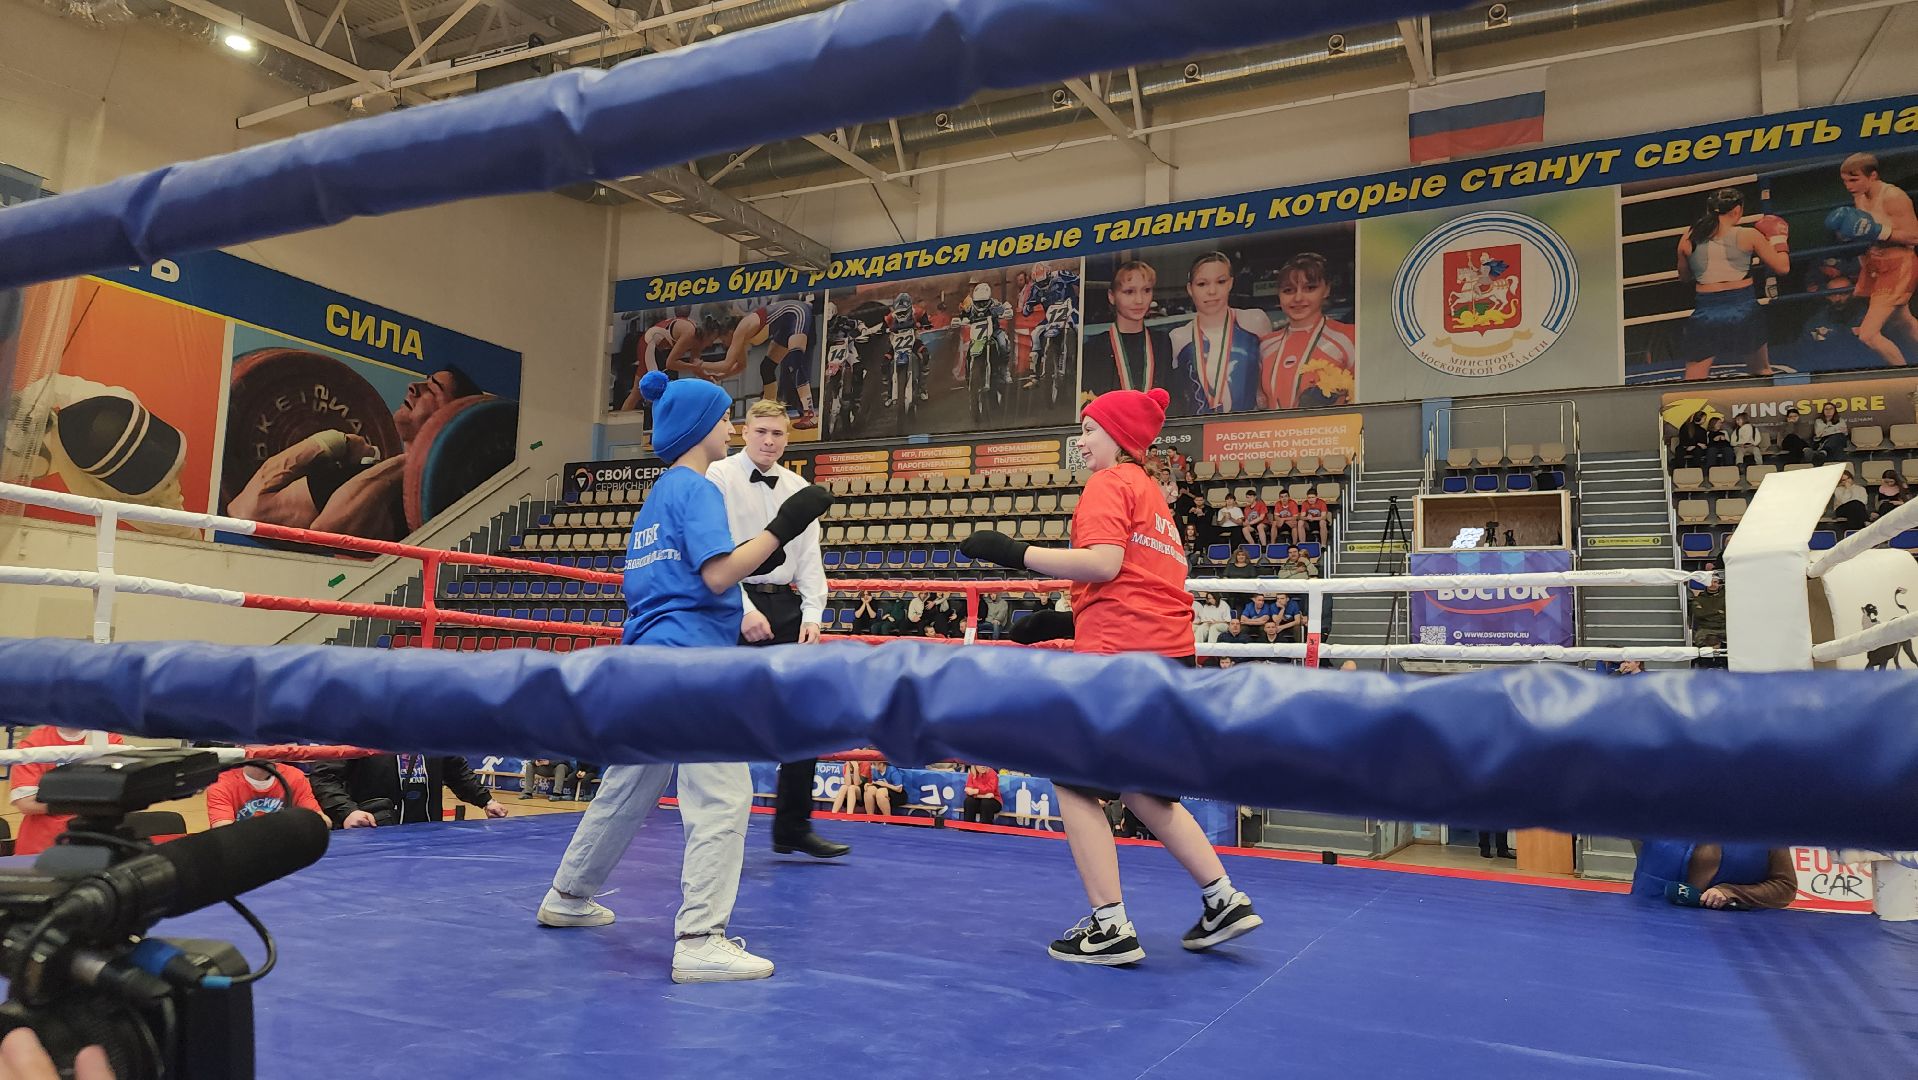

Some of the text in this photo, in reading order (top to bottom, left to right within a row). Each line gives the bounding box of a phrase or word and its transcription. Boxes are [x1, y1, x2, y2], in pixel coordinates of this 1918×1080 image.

[645, 277, 720, 302] Здесь
[977, 226, 1082, 260] новые
[1093, 202, 1255, 244] таланты,
[1268, 173, 1448, 220] которые
[1459, 148, 1622, 191] станут
[1634, 113, 1843, 169] светить
[1050, 306, 1068, 323] 12
[325, 303, 424, 361] СИЛА
[974, 324, 988, 341] 7
[894, 335, 914, 351] 22
[831, 349, 846, 361] 14
[1418, 340, 1550, 376] МОСКОВСКОЙ ОБЛАСТИ
[1449, 351, 1516, 367] МИНСПОРТ
[1215, 425, 1348, 442] РАБОТАЕТ КУРЬЕРСКАЯ
[1223, 436, 1340, 452] СЛУЖБА ПО МОСКВЕ
[829, 453, 880, 462] ТЕЛЕВИЗОРЫ
[993, 455, 1040, 465] ПЫЛЕСОСЫ
[1209, 445, 1356, 462] И МОСКОВСКОЙ ОБЛАСТИ
[832, 465, 871, 473] ТЕЛЕФОНЫ
[897, 459, 966, 470] ПАРОГЕНЕРАТОРЫ
[595, 465, 632, 482] СВОЙ
[595, 479, 654, 492] СЕРВИСНЫЙ
[1811, 873, 1865, 899] CAR
